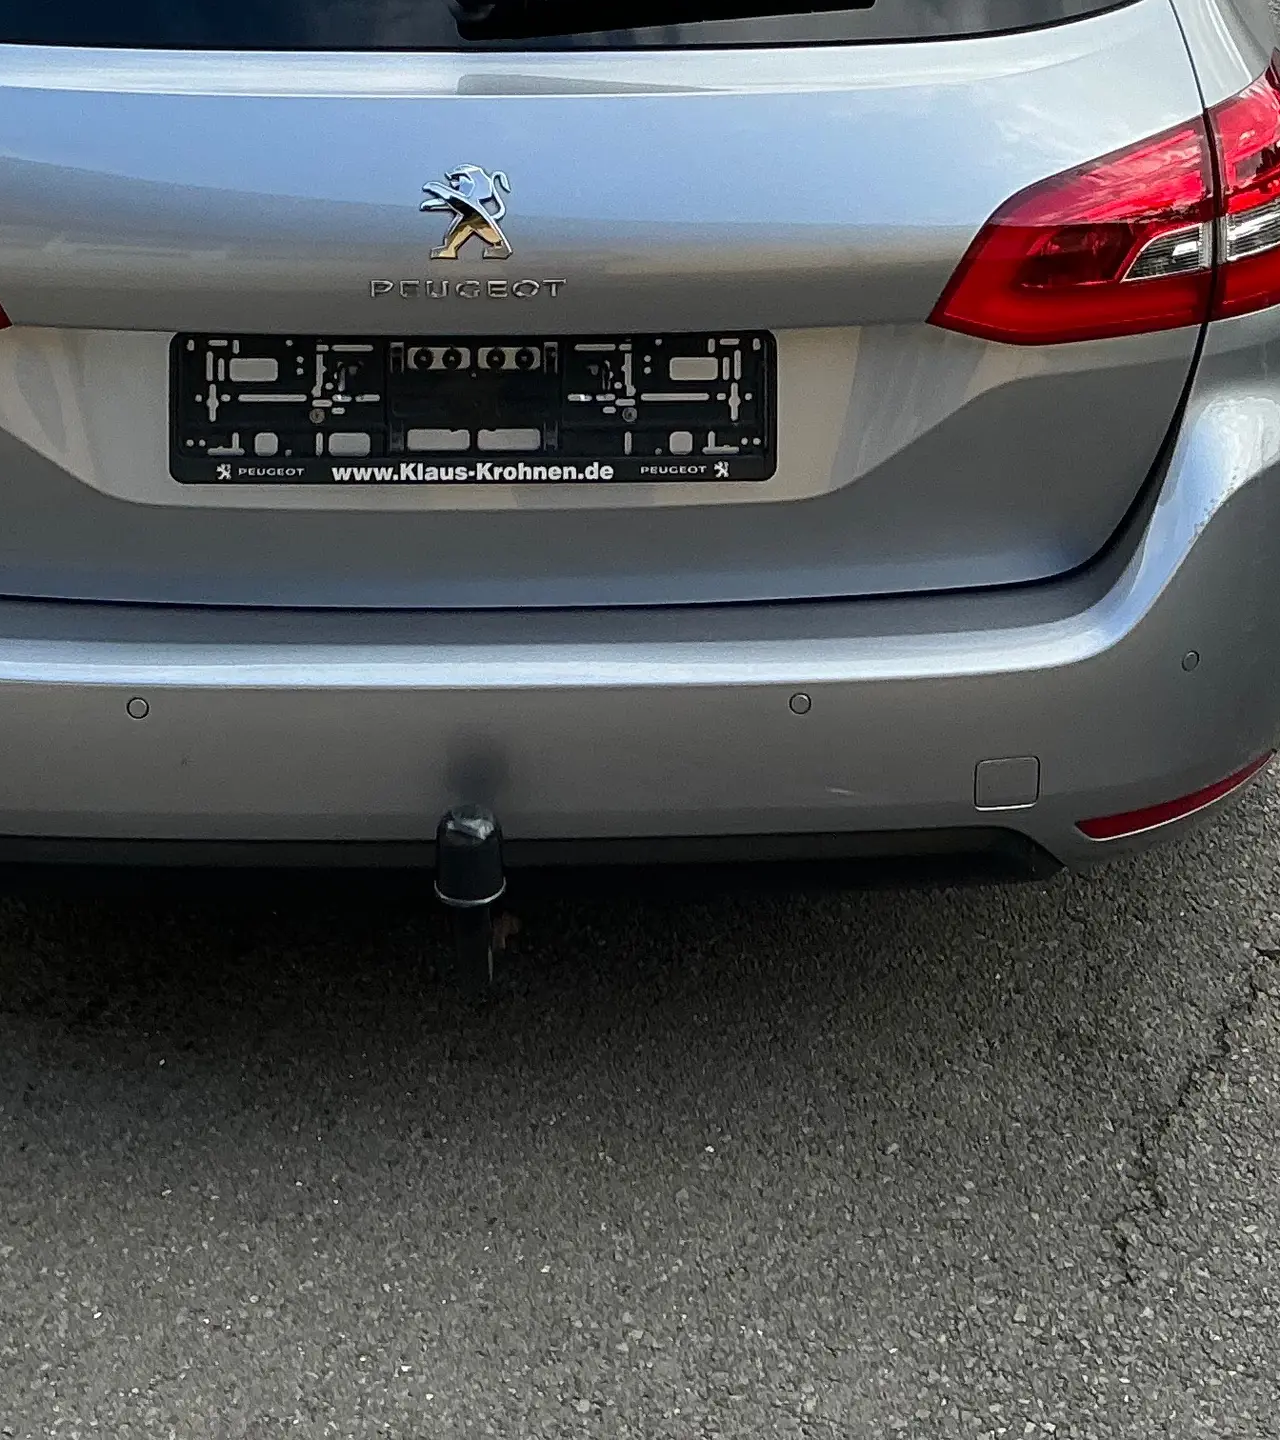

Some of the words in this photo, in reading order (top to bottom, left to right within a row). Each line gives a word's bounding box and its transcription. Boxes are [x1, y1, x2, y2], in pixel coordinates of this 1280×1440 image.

[369, 278, 567, 300] PEUGEOT
[238, 466, 306, 477] PEUGEOT
[331, 462, 615, 482] www.Klaus-Krohnen.de
[640, 464, 708, 475] PEUGEOT
